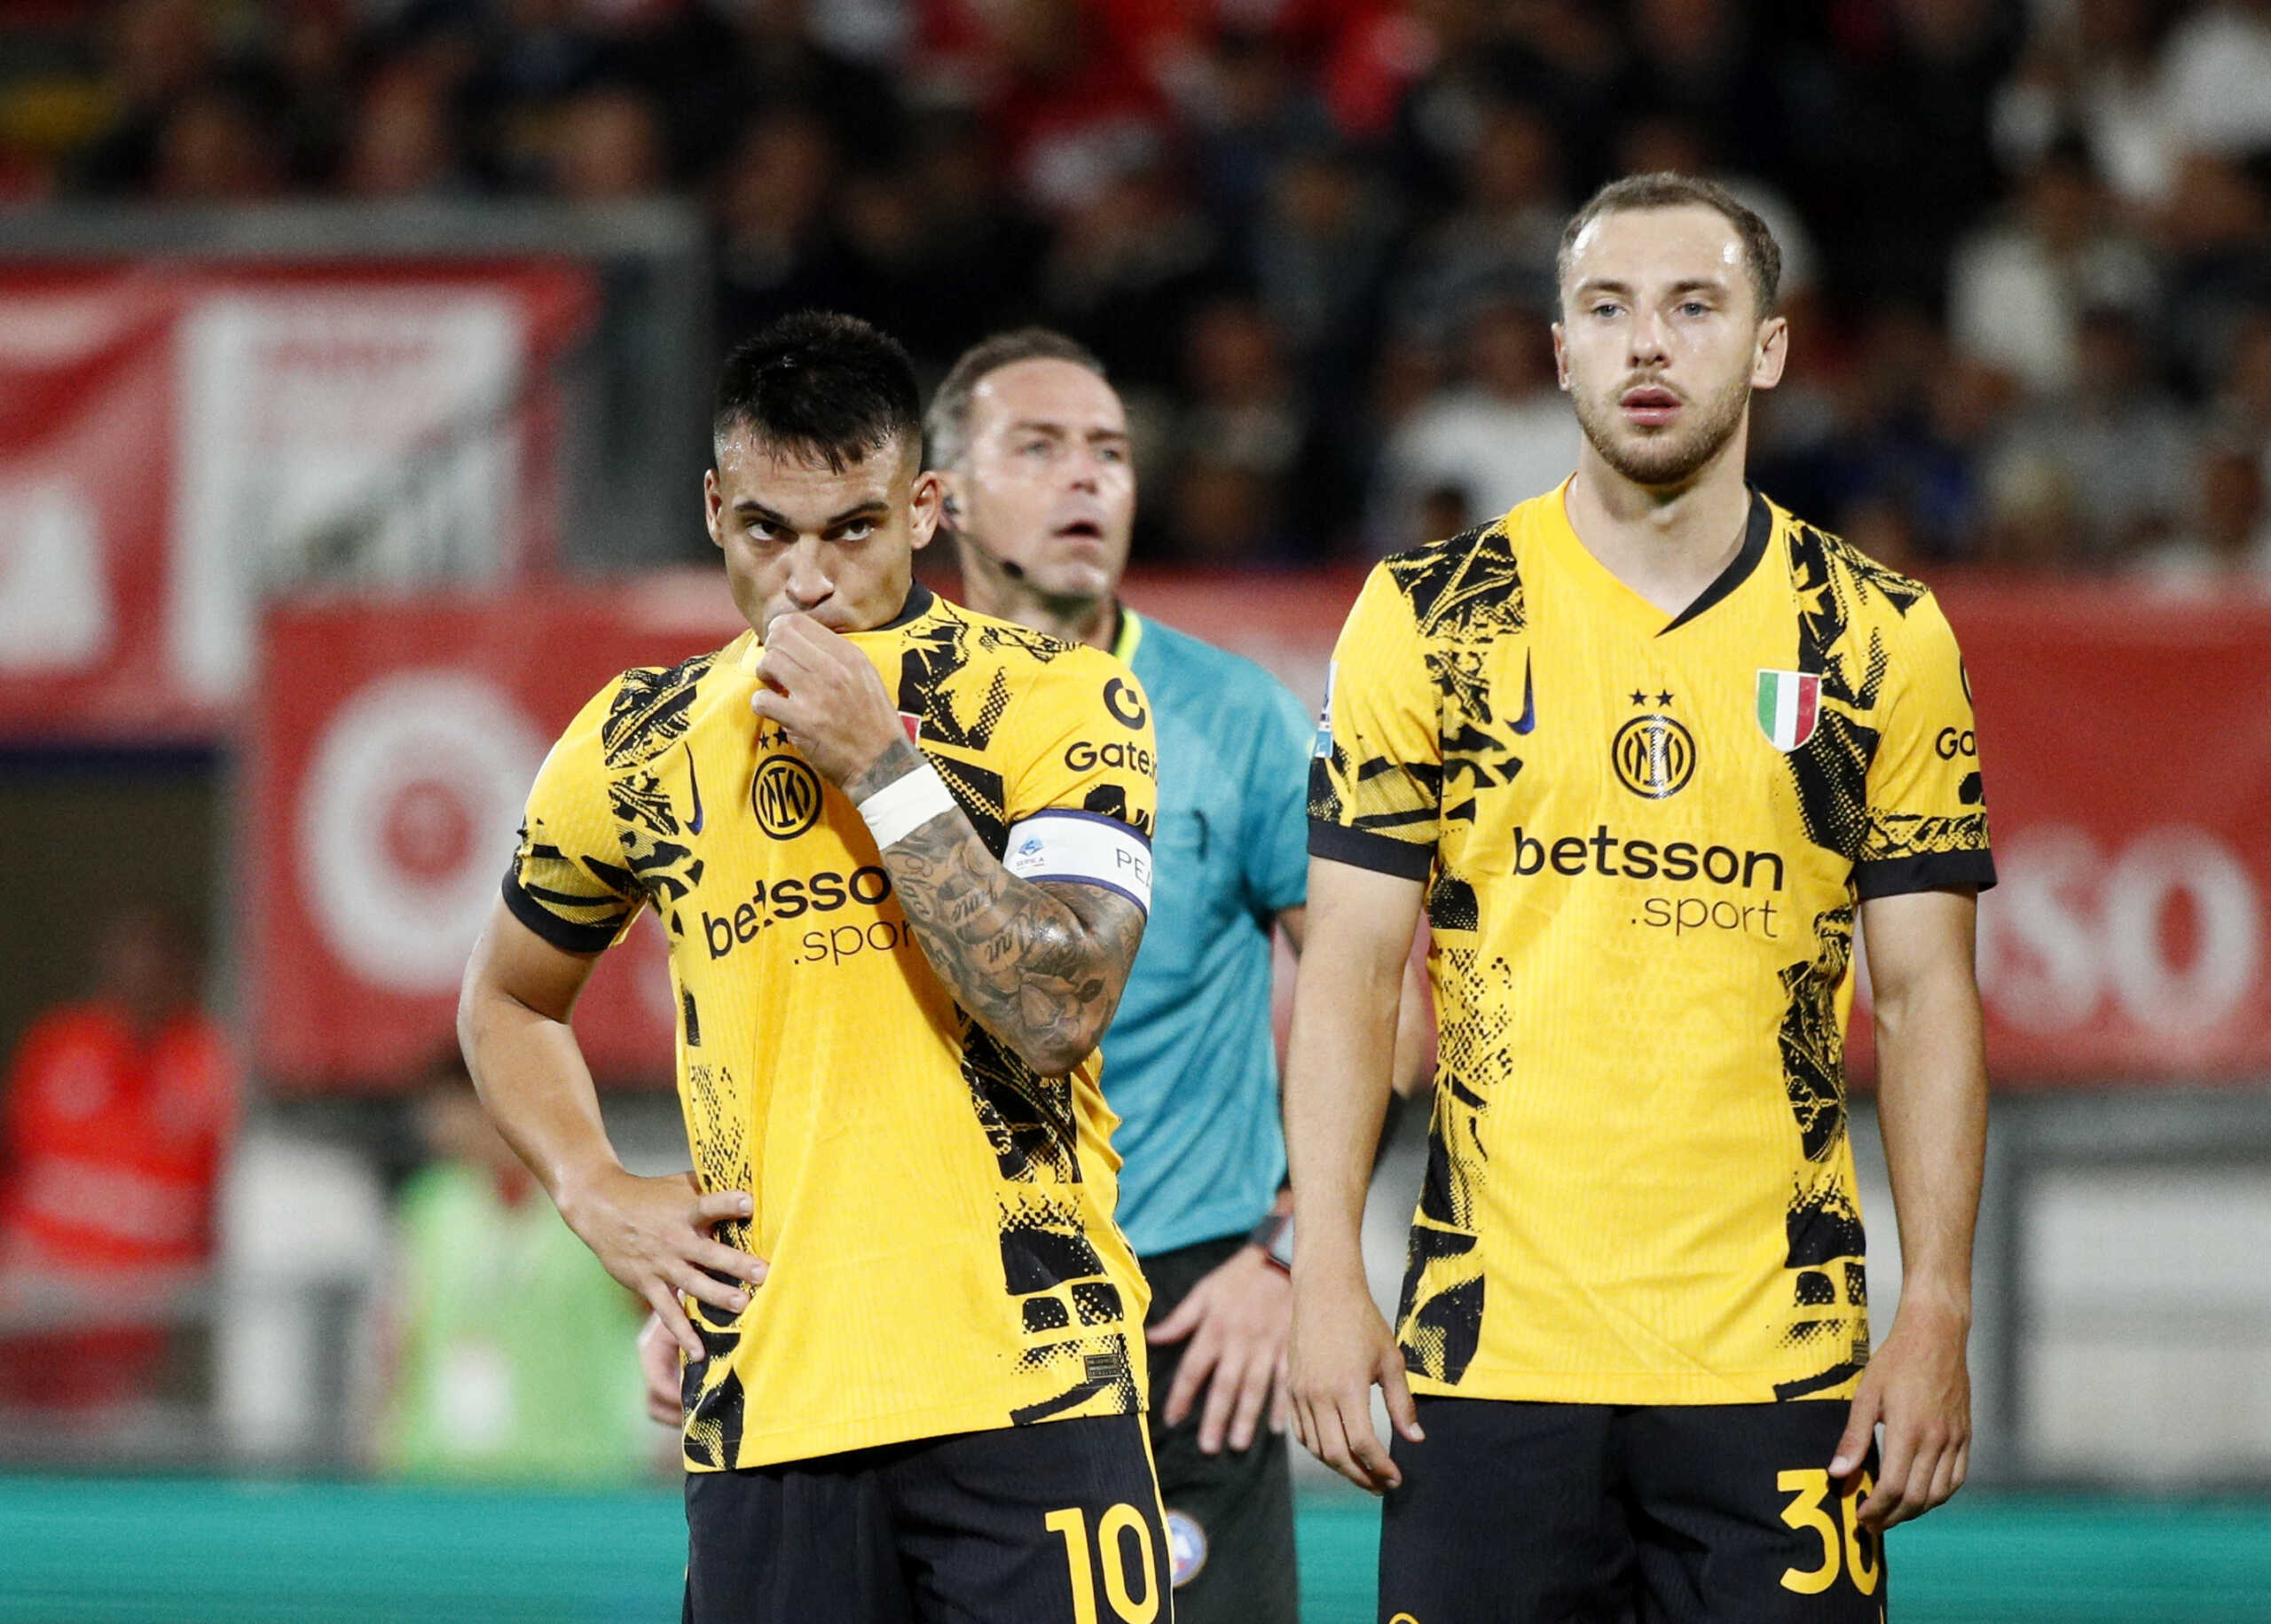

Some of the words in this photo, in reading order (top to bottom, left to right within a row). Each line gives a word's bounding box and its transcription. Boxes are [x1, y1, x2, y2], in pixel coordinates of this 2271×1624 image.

[1512, 824, 1784, 891] betsson
[1631, 898, 1778, 938] .sport
[1044, 1502, 1159, 1624] 10
